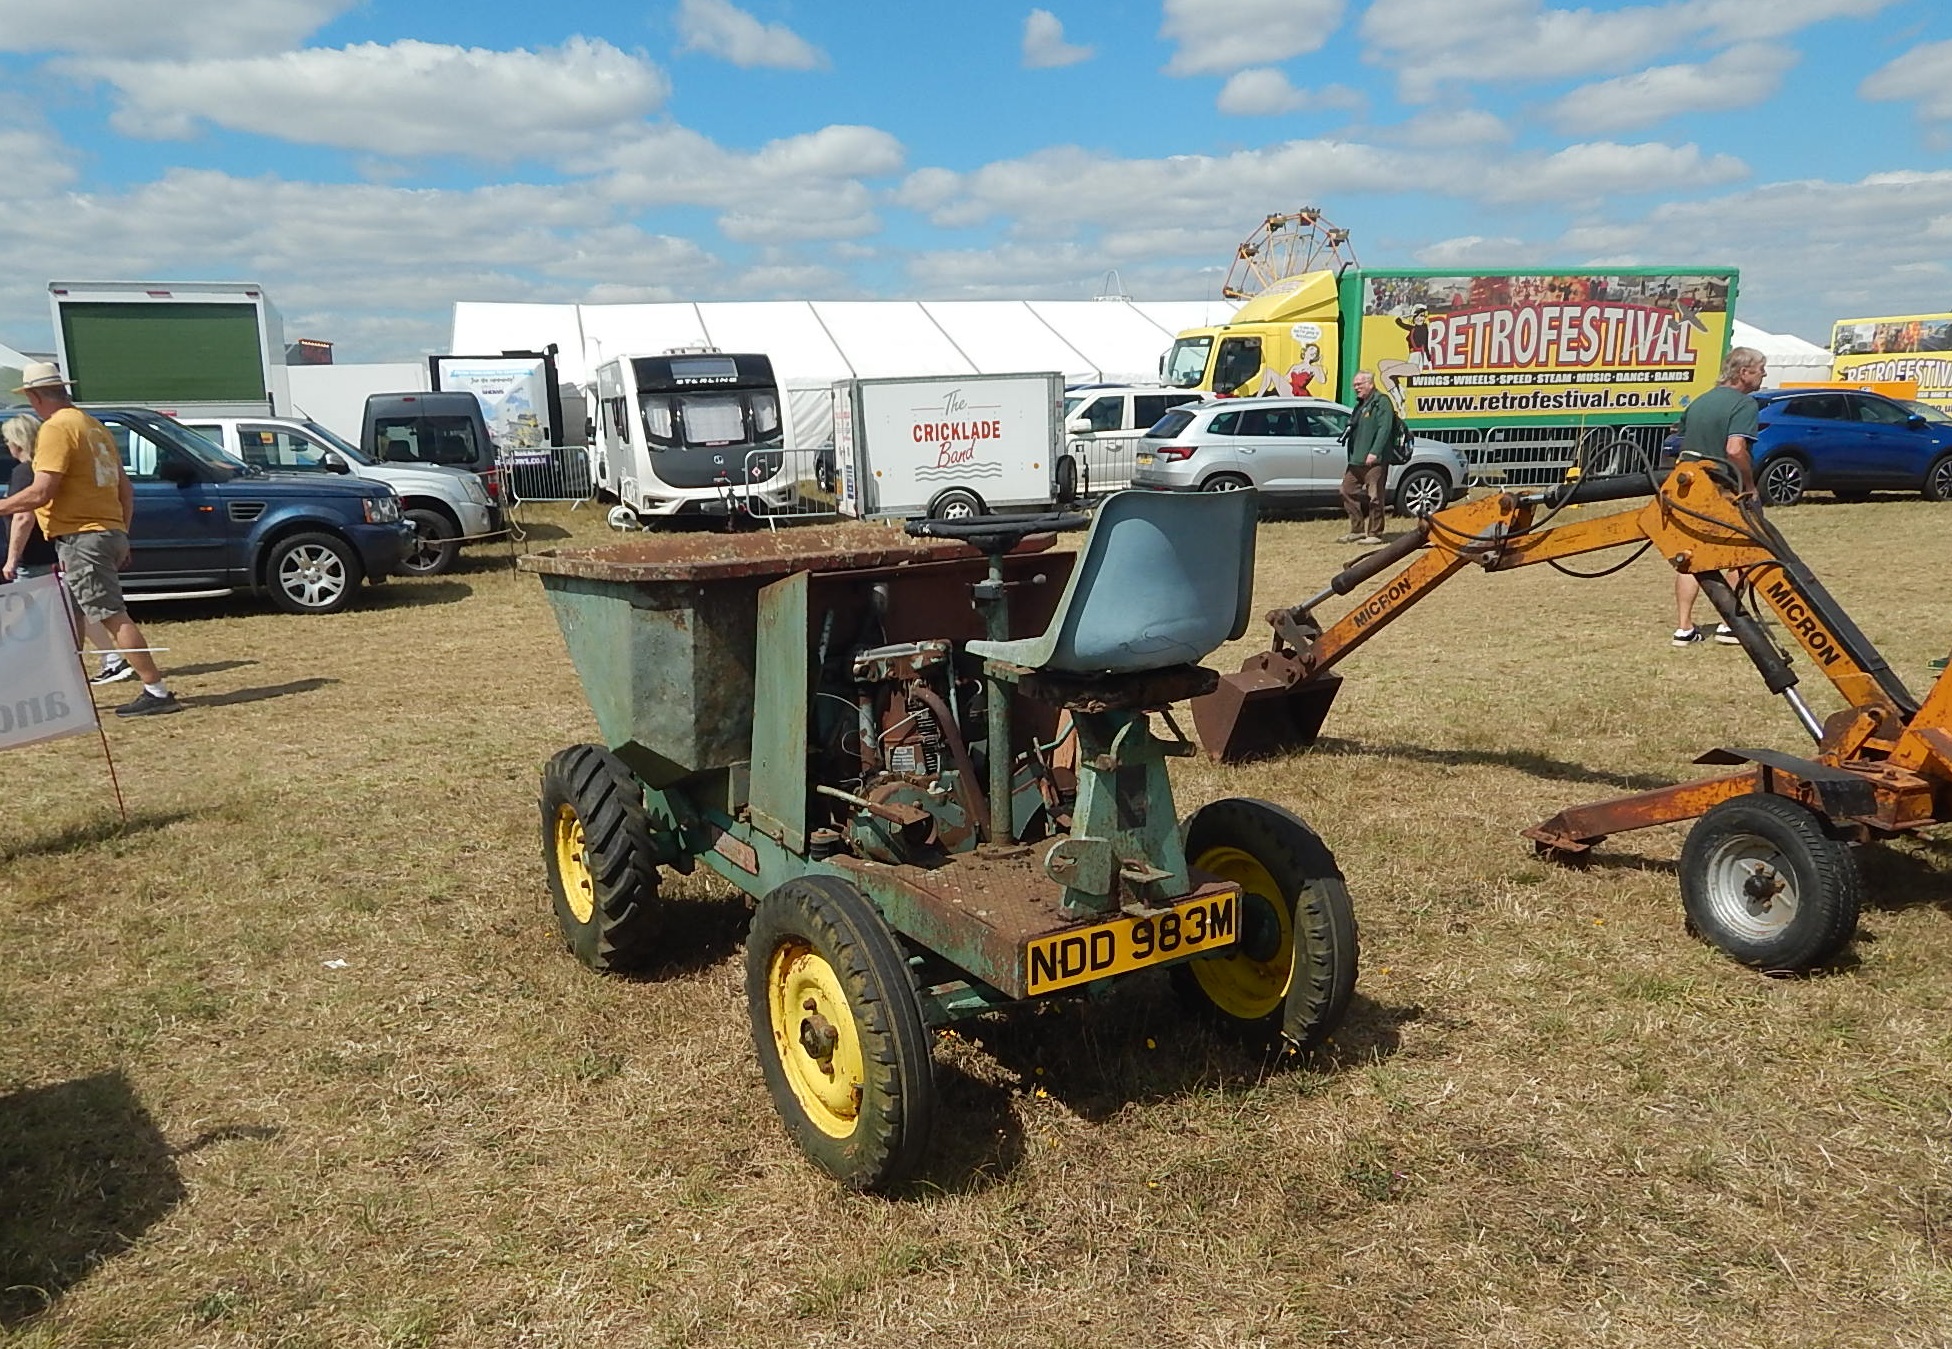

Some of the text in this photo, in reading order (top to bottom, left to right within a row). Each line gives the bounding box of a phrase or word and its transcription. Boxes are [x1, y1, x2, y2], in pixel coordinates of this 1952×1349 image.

[1427, 304, 1696, 366] RETROFESTIVAL
[676, 377, 738, 385] STERLING
[1412, 371, 1691, 386] WINGS WHEELS SPEED STEAM MUSIC DANCE BANDS
[943, 389, 967, 416] The
[1417, 389, 1672, 412] www.retrofestival.co.uk
[912, 420, 1001, 443] CRICKLADE
[937, 437, 976, 468] Band
[1353, 577, 1412, 628] MICRON
[1766, 580, 1841, 667] MICRON
[1031, 897, 1233, 987] NDD 983M
